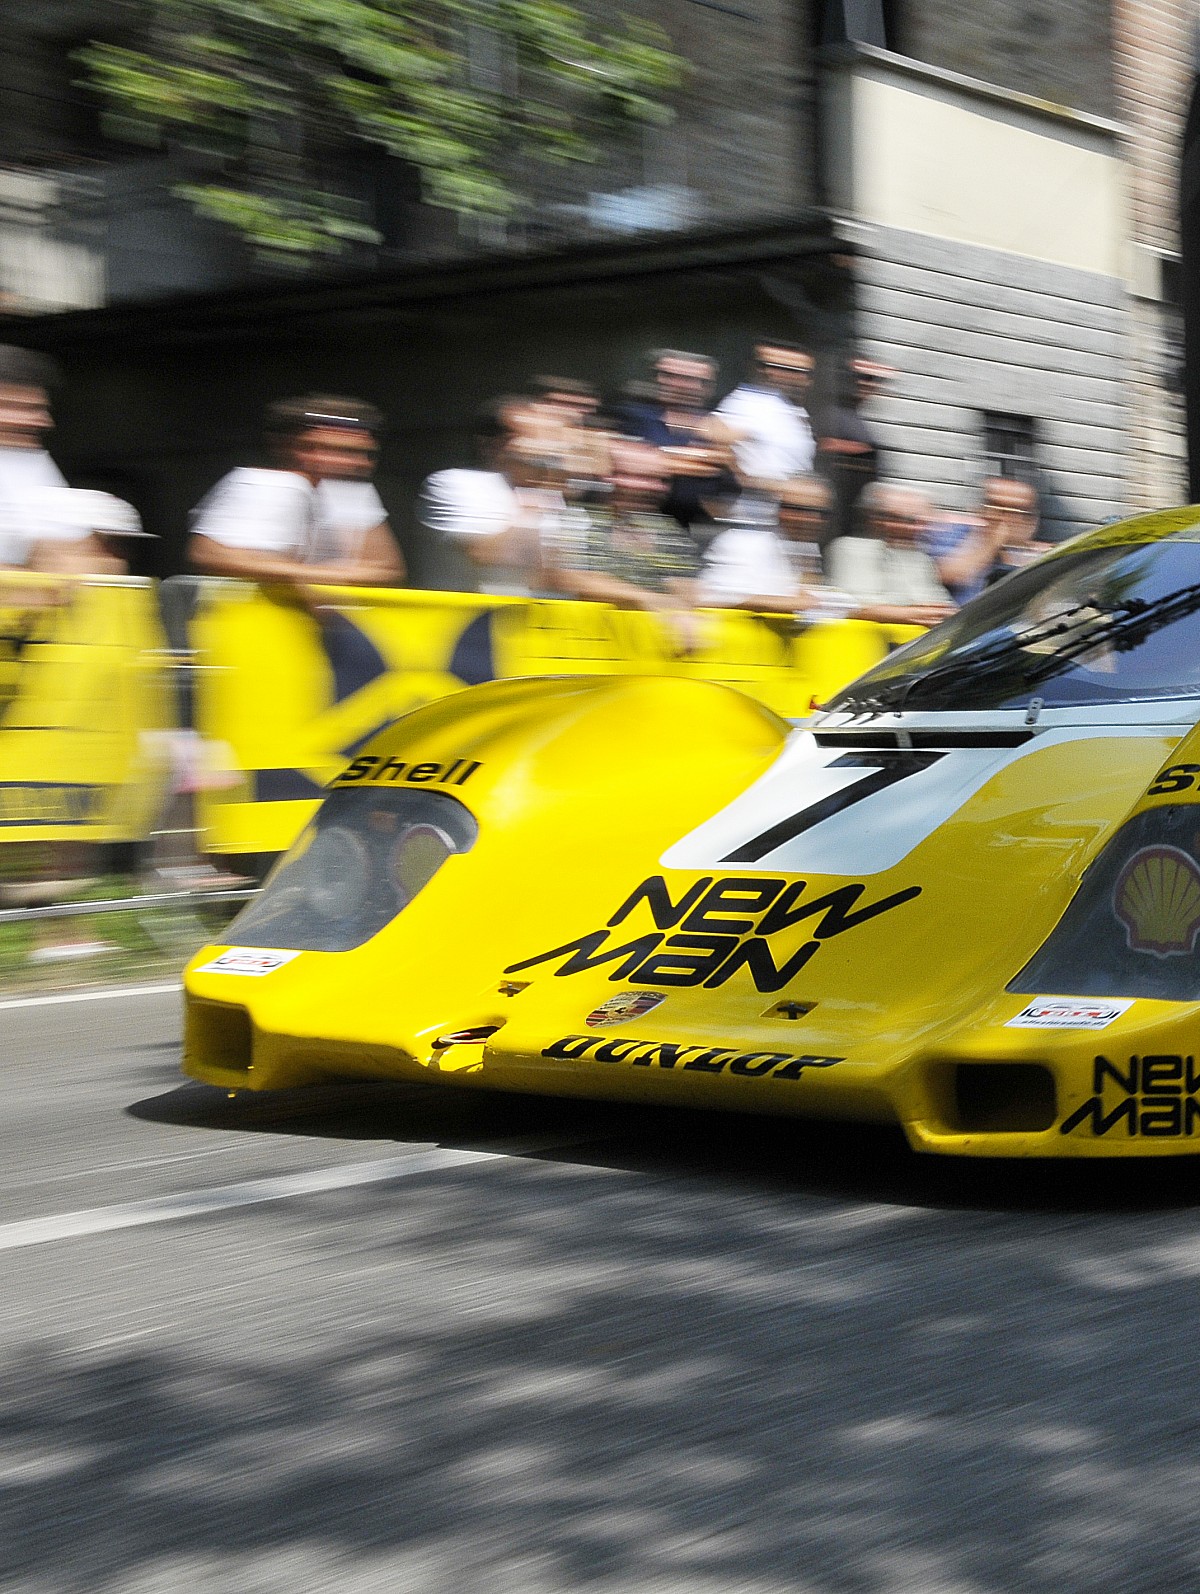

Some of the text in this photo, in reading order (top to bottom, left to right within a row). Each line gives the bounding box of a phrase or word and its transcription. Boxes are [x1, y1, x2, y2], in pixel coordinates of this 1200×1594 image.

[338, 755, 483, 787] Shell
[716, 750, 951, 863] 7
[540, 1034, 848, 1080] DUNLOP
